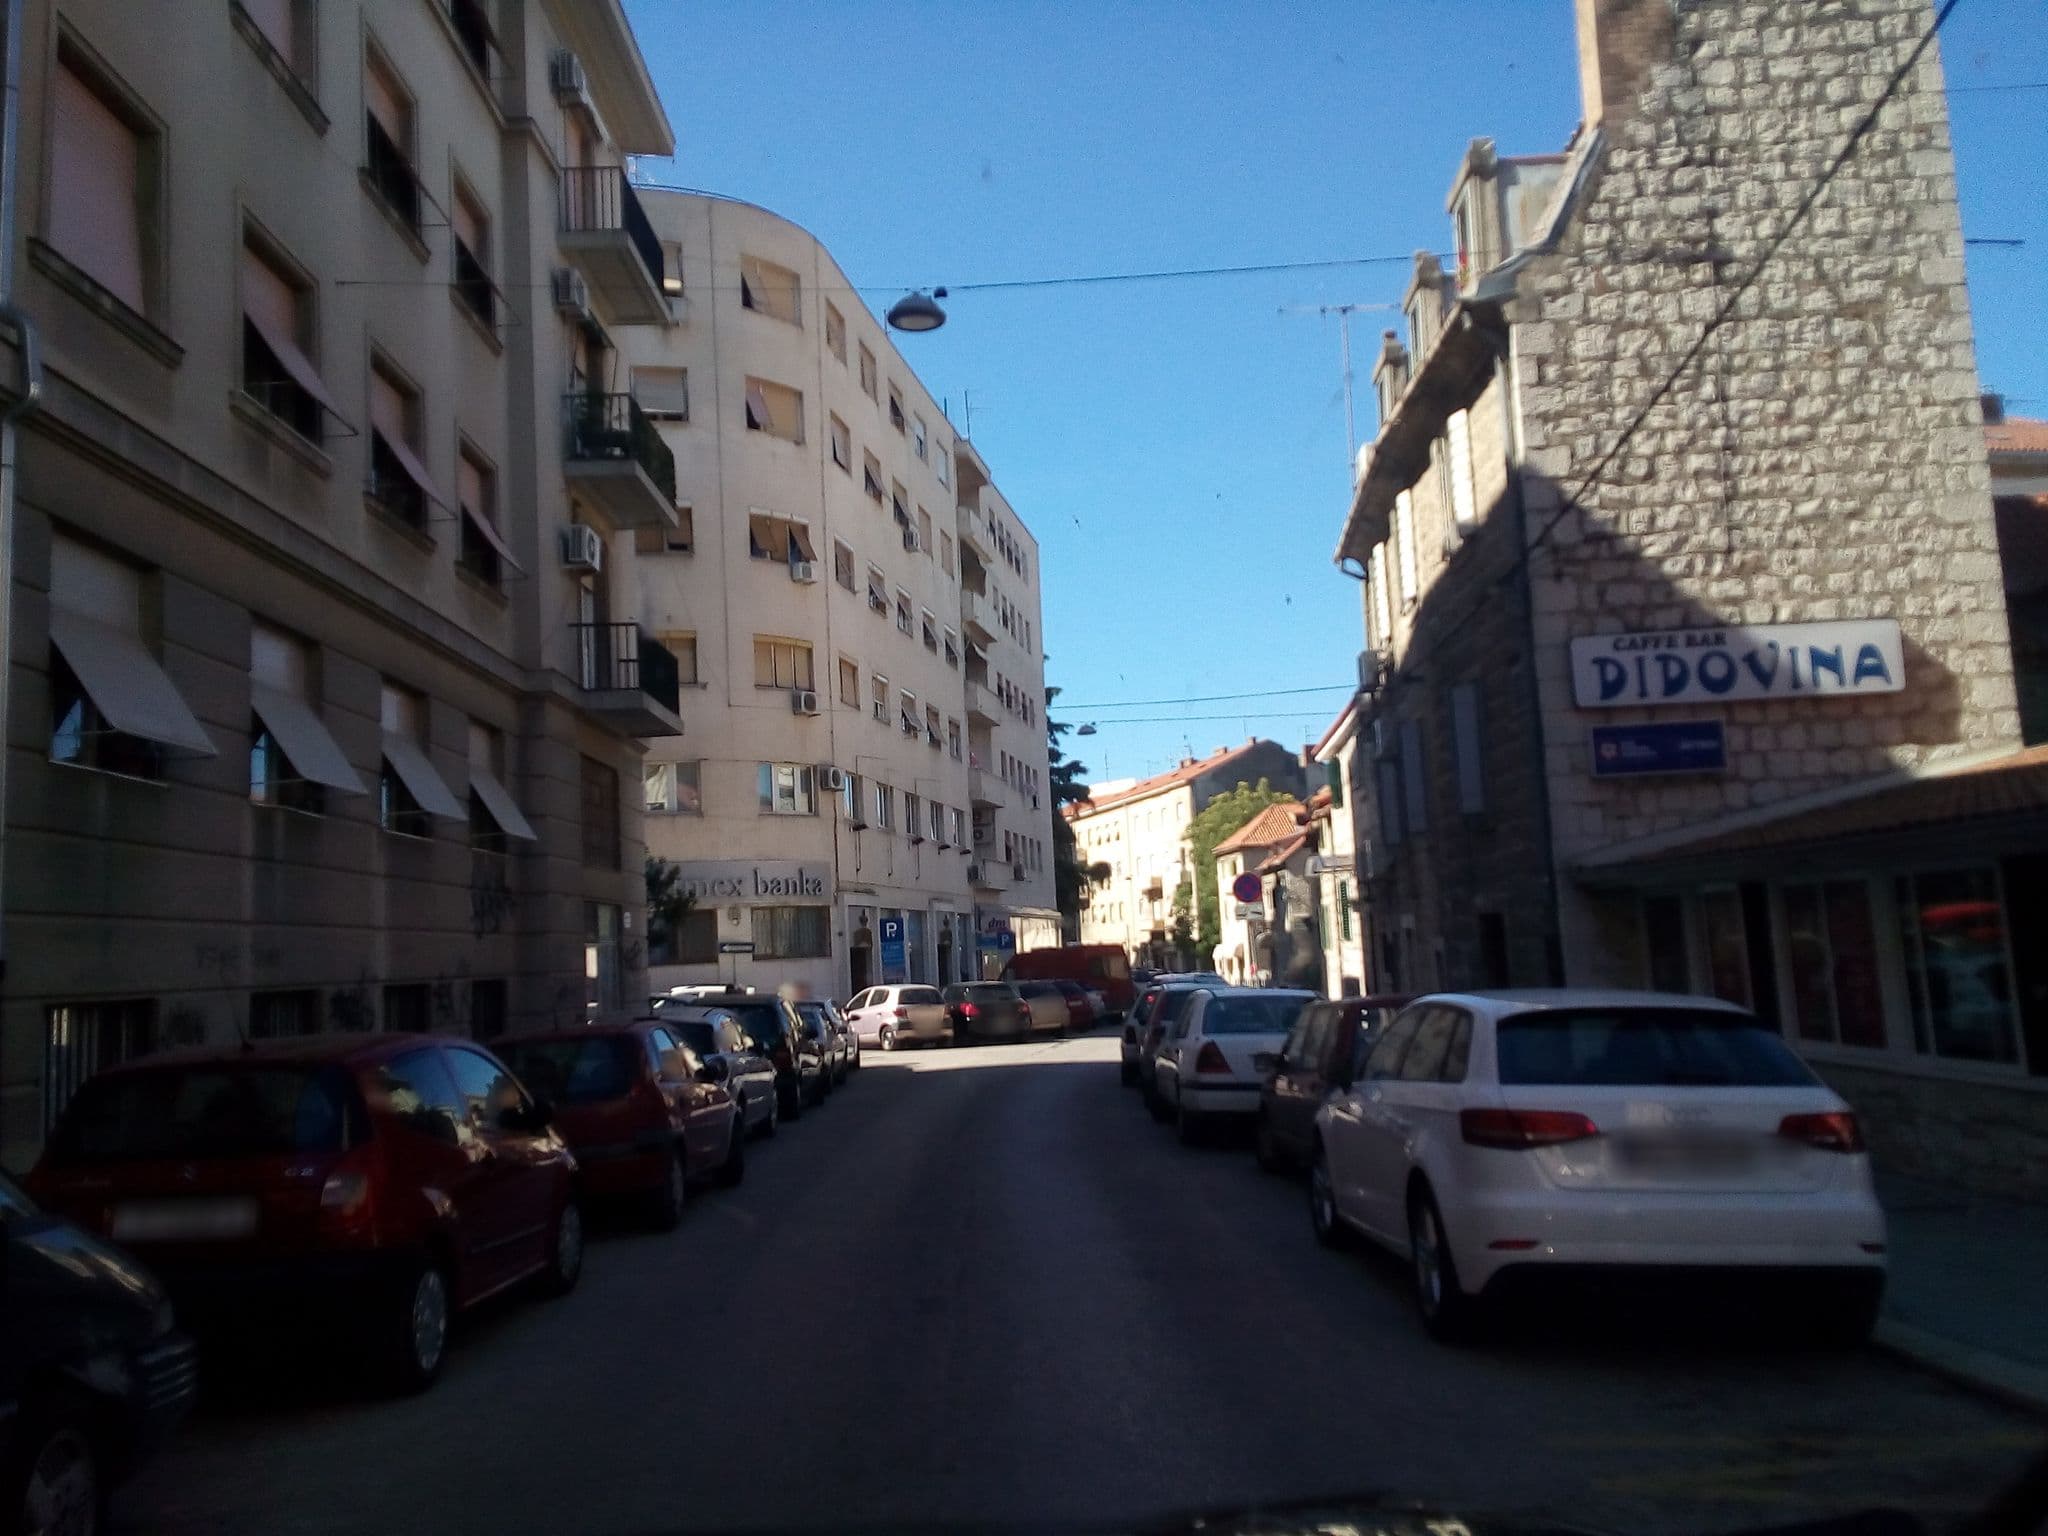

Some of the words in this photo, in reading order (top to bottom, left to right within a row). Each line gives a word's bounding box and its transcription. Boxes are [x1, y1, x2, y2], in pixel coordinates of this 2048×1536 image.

[1592, 640, 1892, 700] DIDOVINA
[754, 868, 824, 897] banka
[886, 922, 898, 938] P
